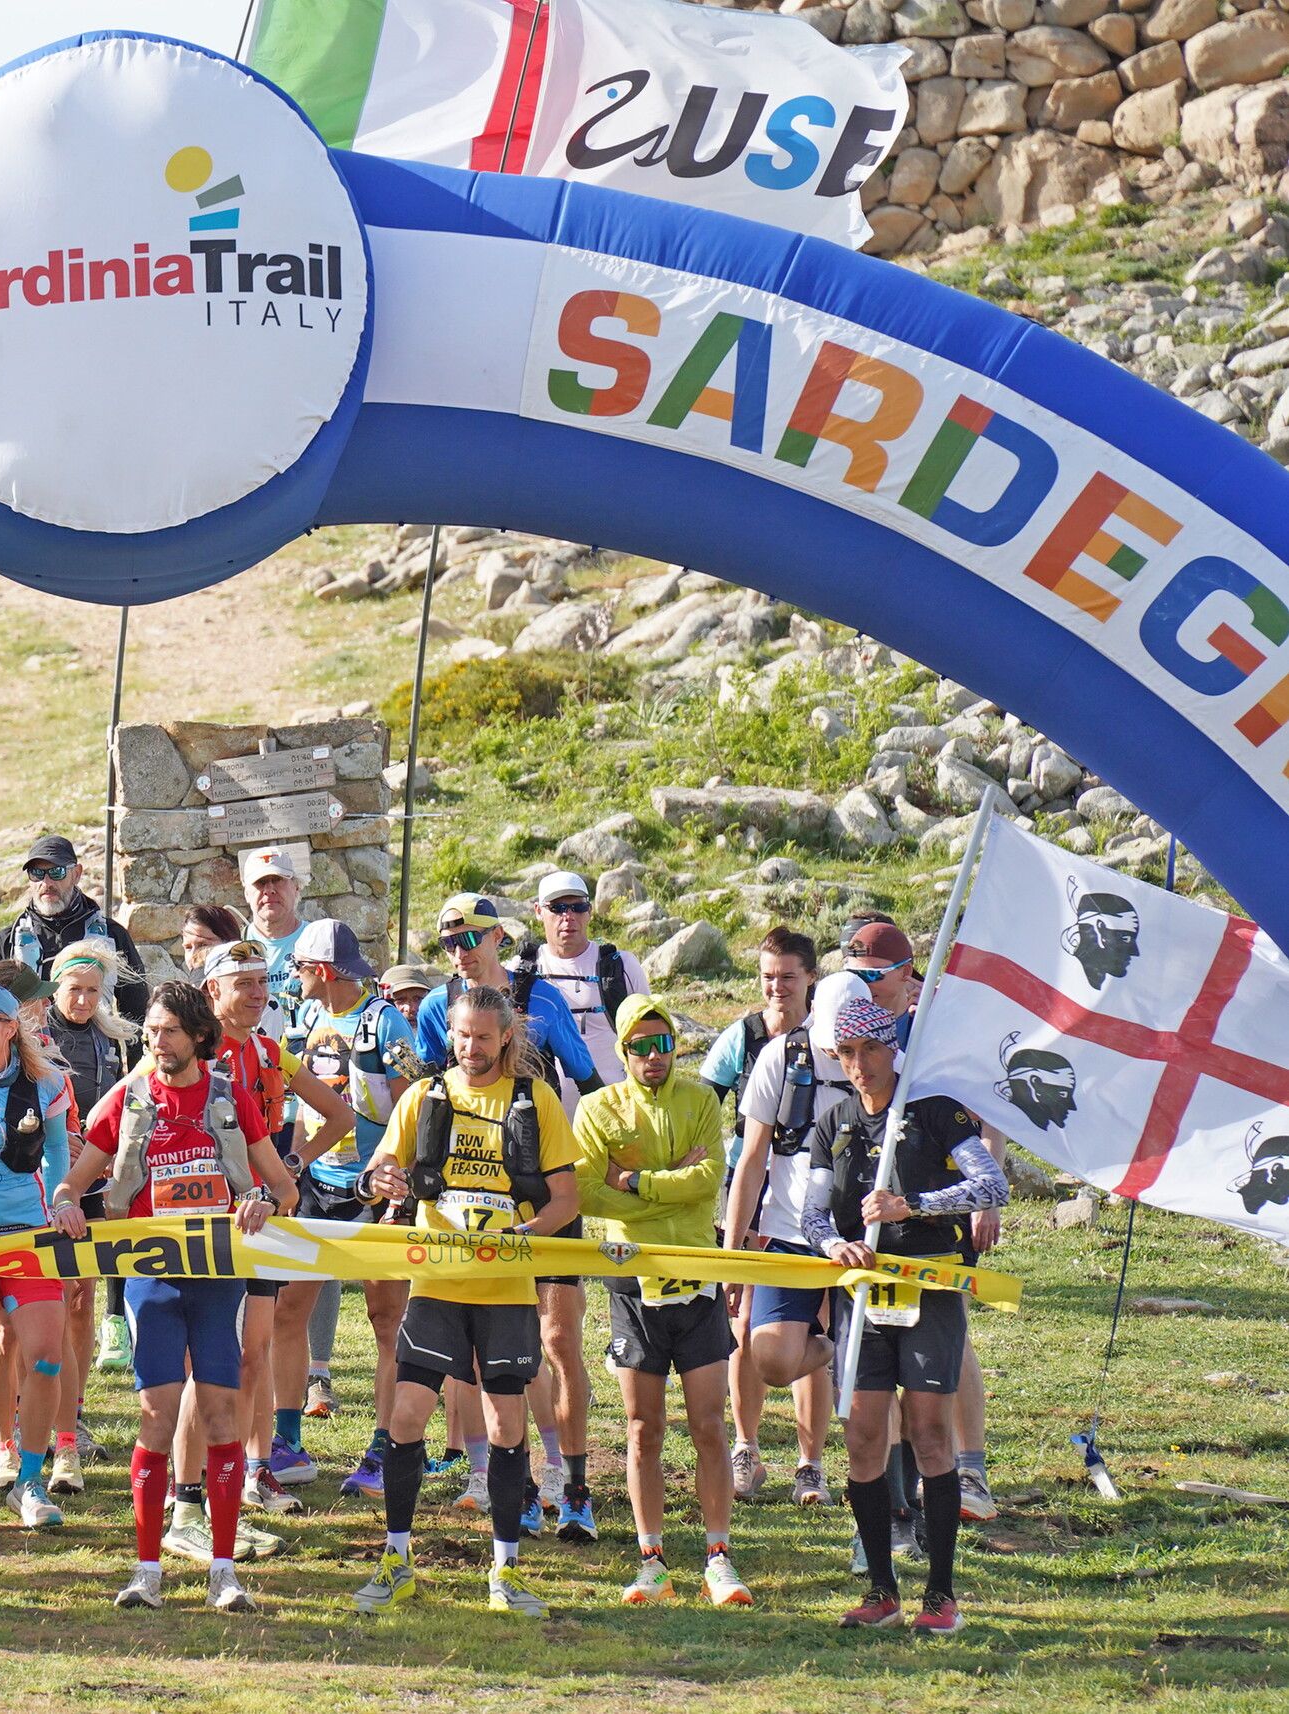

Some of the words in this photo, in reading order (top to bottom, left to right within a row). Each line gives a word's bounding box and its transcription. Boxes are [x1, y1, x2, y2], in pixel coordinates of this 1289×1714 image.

[205, 299, 343, 333] ITALY
[547, 289, 1289, 780] SARDEG
[455, 1133, 484, 1148] RUN
[171, 1181, 214, 1201] 201
[463, 1207, 494, 1232] 17
[406, 1231, 531, 1249] SARDEGNA
[406, 1245, 533, 1265] OUTDOOR
